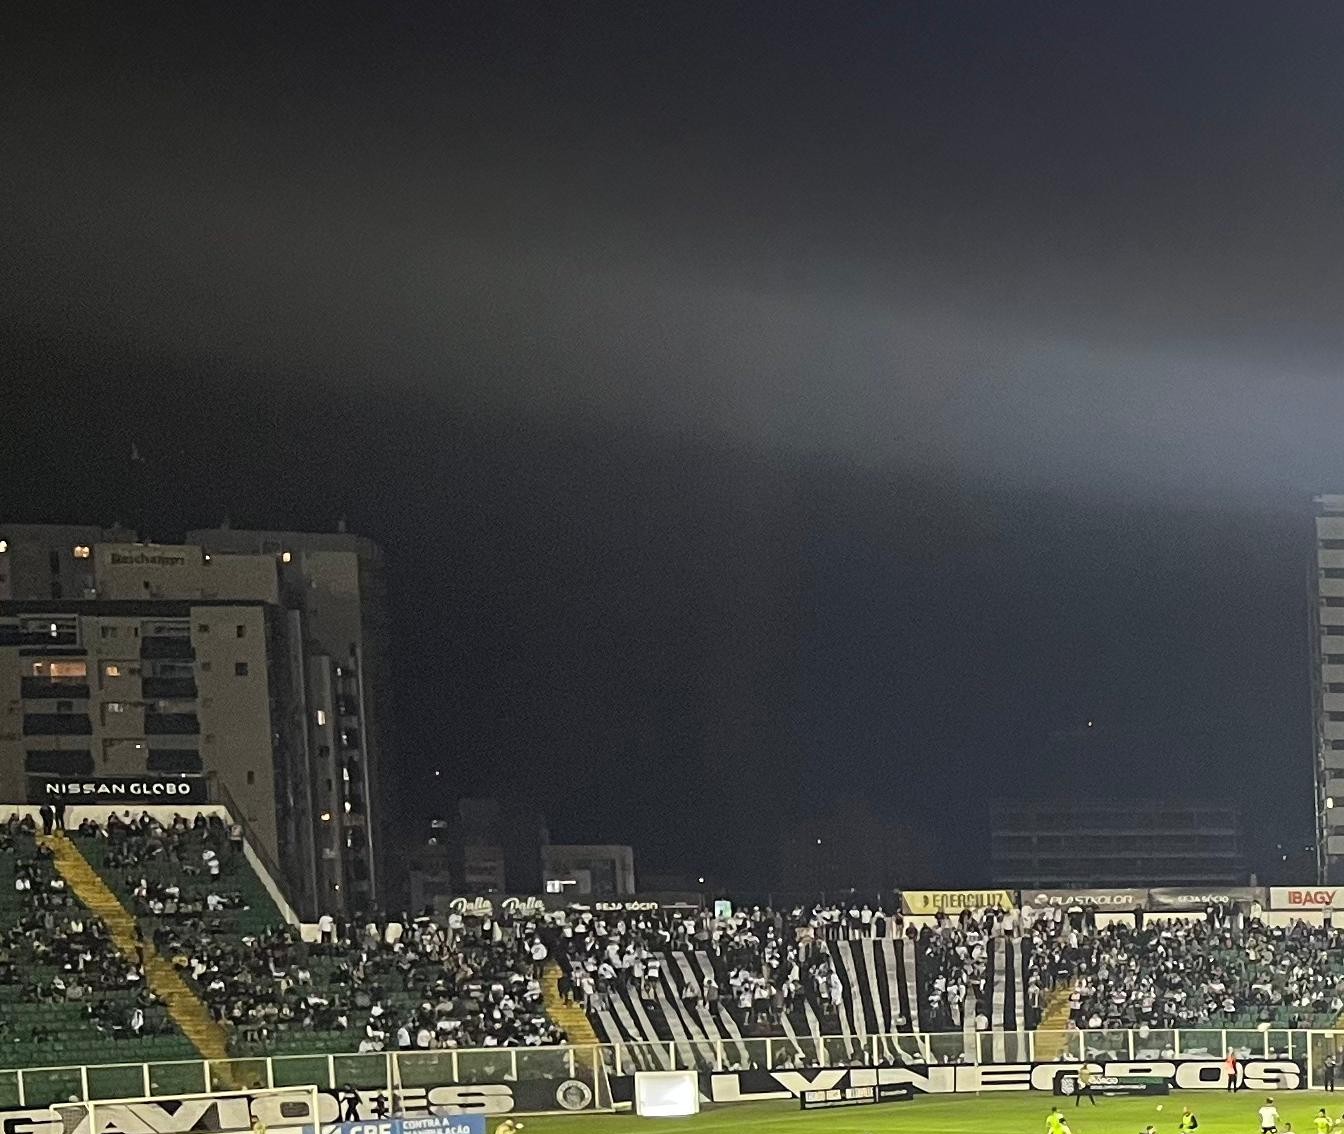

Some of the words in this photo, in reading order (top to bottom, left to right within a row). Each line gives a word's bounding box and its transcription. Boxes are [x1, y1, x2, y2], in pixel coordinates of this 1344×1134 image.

[46, 783, 125, 794] NISSAN
[130, 783, 191, 794] GLOBO
[1288, 891, 1336, 905] IBAGY
[403, 1118, 440, 1131] CONTRA
[441, 1117, 449, 1126] A
